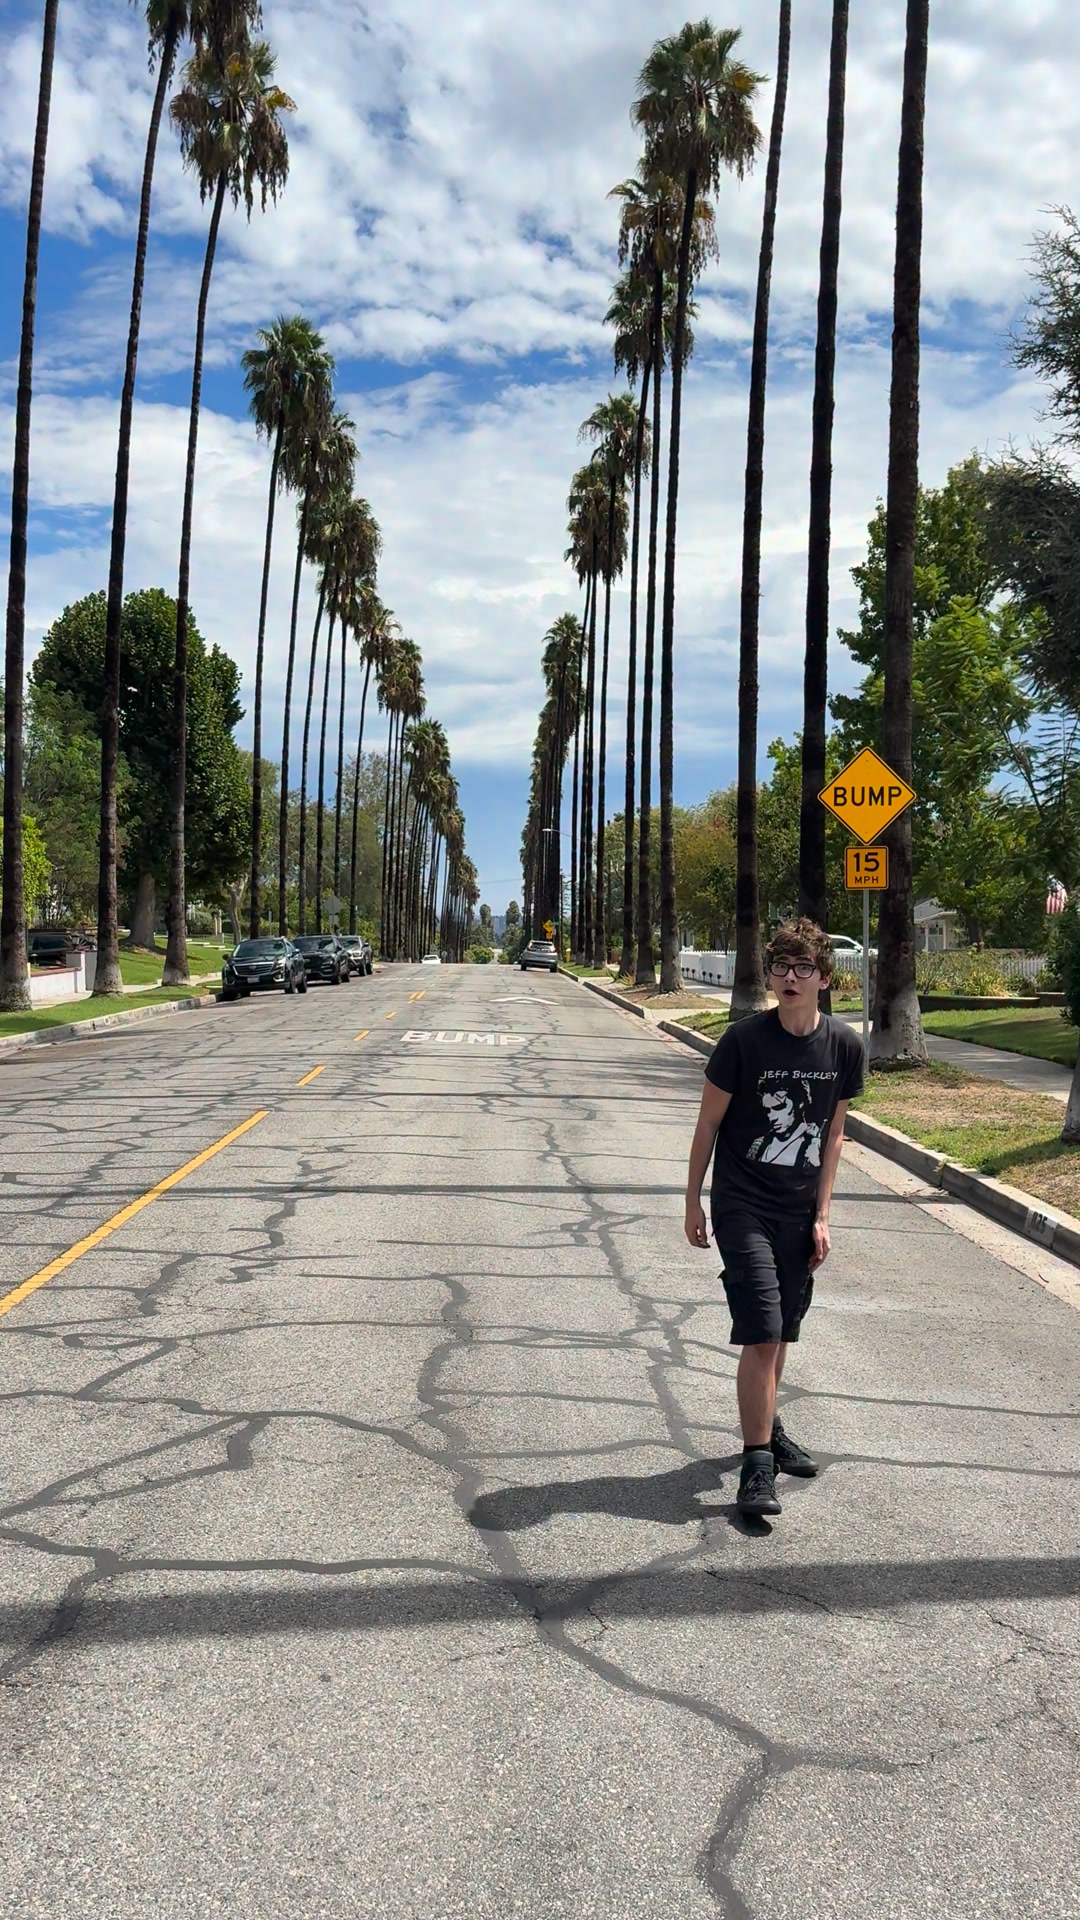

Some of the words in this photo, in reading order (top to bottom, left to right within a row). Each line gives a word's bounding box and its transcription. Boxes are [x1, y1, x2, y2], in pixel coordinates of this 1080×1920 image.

[833, 786, 902, 807] BUMP
[853, 852, 880, 873] 15
[854, 876, 879, 884] MPH
[400, 1030, 527, 1046] BUMP
[759, 1070, 789, 1080] JEFF
[792, 1070, 838, 1081] BUCKLEY
